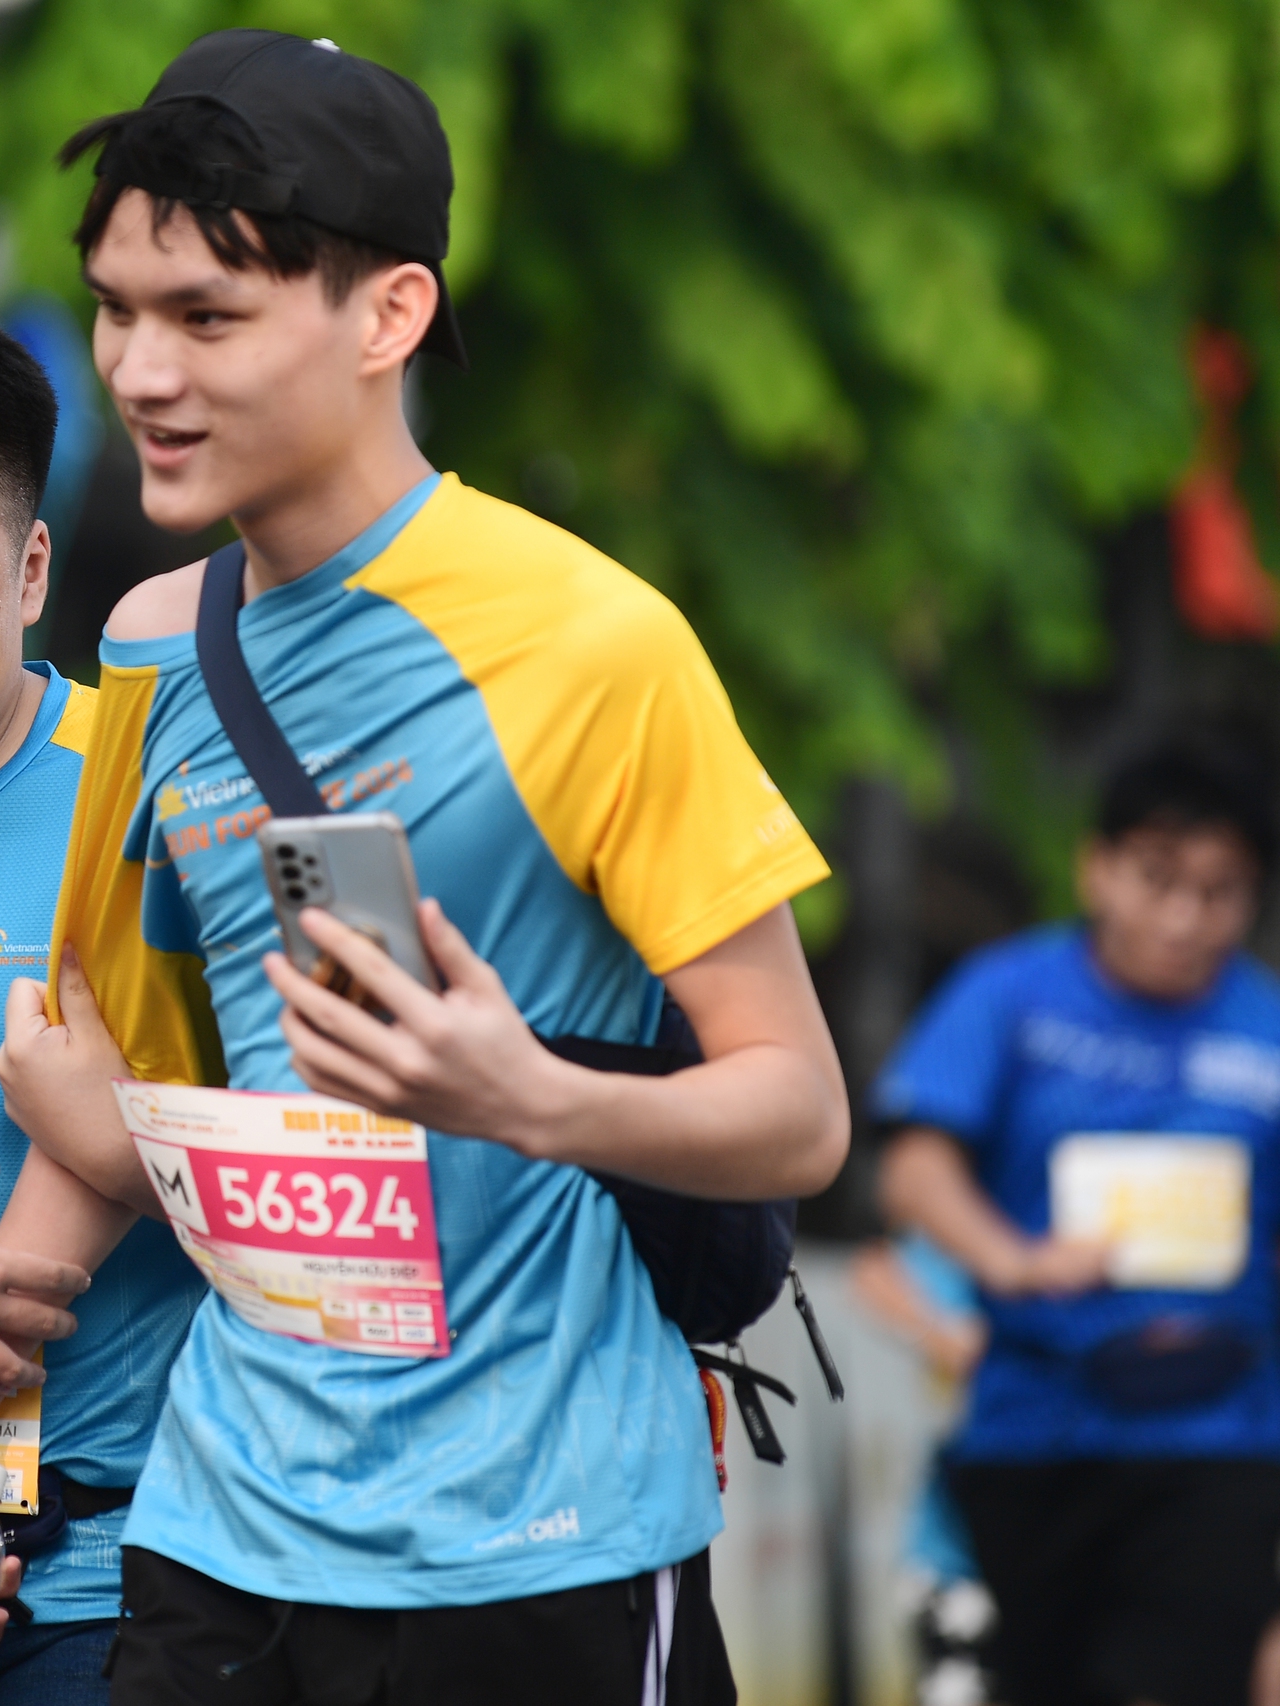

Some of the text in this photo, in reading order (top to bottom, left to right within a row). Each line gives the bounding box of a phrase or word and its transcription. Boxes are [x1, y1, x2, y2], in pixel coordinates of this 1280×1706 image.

[12, 956, 35, 965] FOR
[149, 1158, 419, 1241] M 56324
